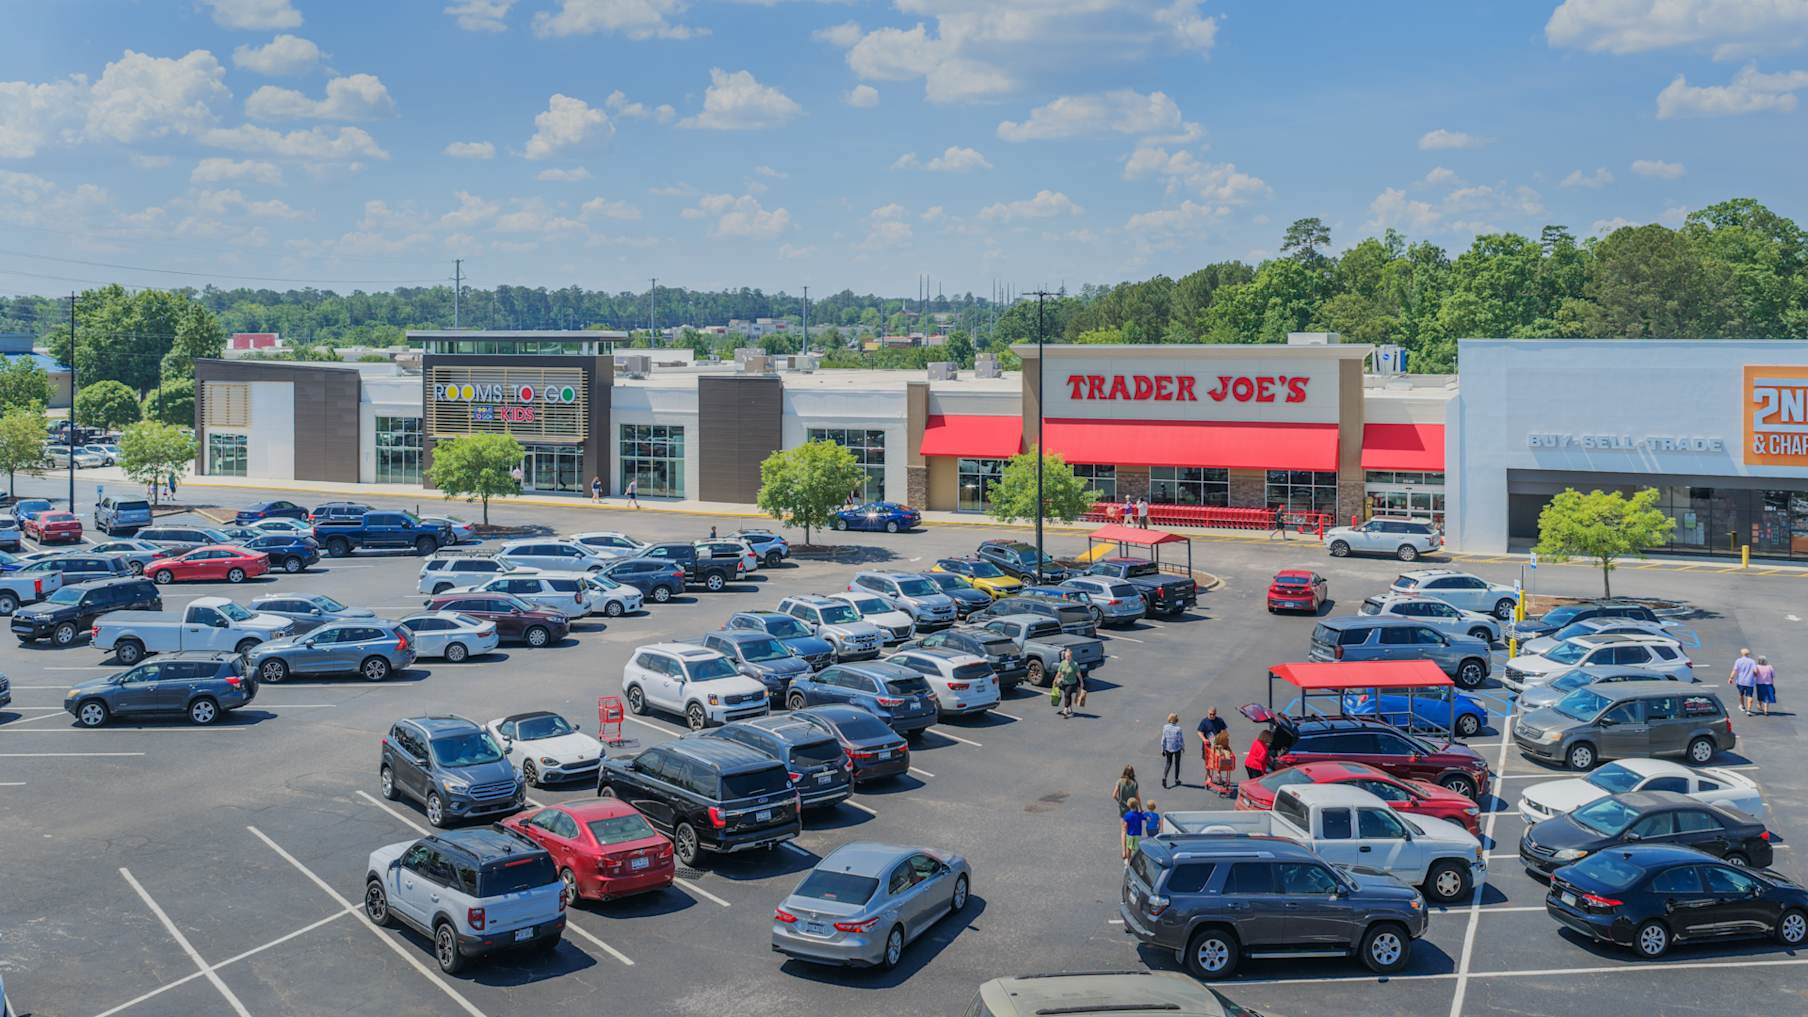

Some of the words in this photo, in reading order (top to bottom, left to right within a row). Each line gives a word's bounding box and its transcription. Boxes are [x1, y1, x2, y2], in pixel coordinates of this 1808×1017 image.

[434, 383, 503, 402] ROOMS
[511, 384, 535, 404] TO
[544, 385, 576, 404] GO
[1067, 375, 1198, 401] TRADER
[1207, 376, 1310, 403] JOE'S
[501, 407, 535, 422] KIDS
[1754, 385, 1808, 432] 2N
[1528, 432, 1572, 448] BUY
[1582, 433, 1634, 449] SELL
[1646, 435, 1724, 452] TRADE
[1753, 434, 1767, 455] &
